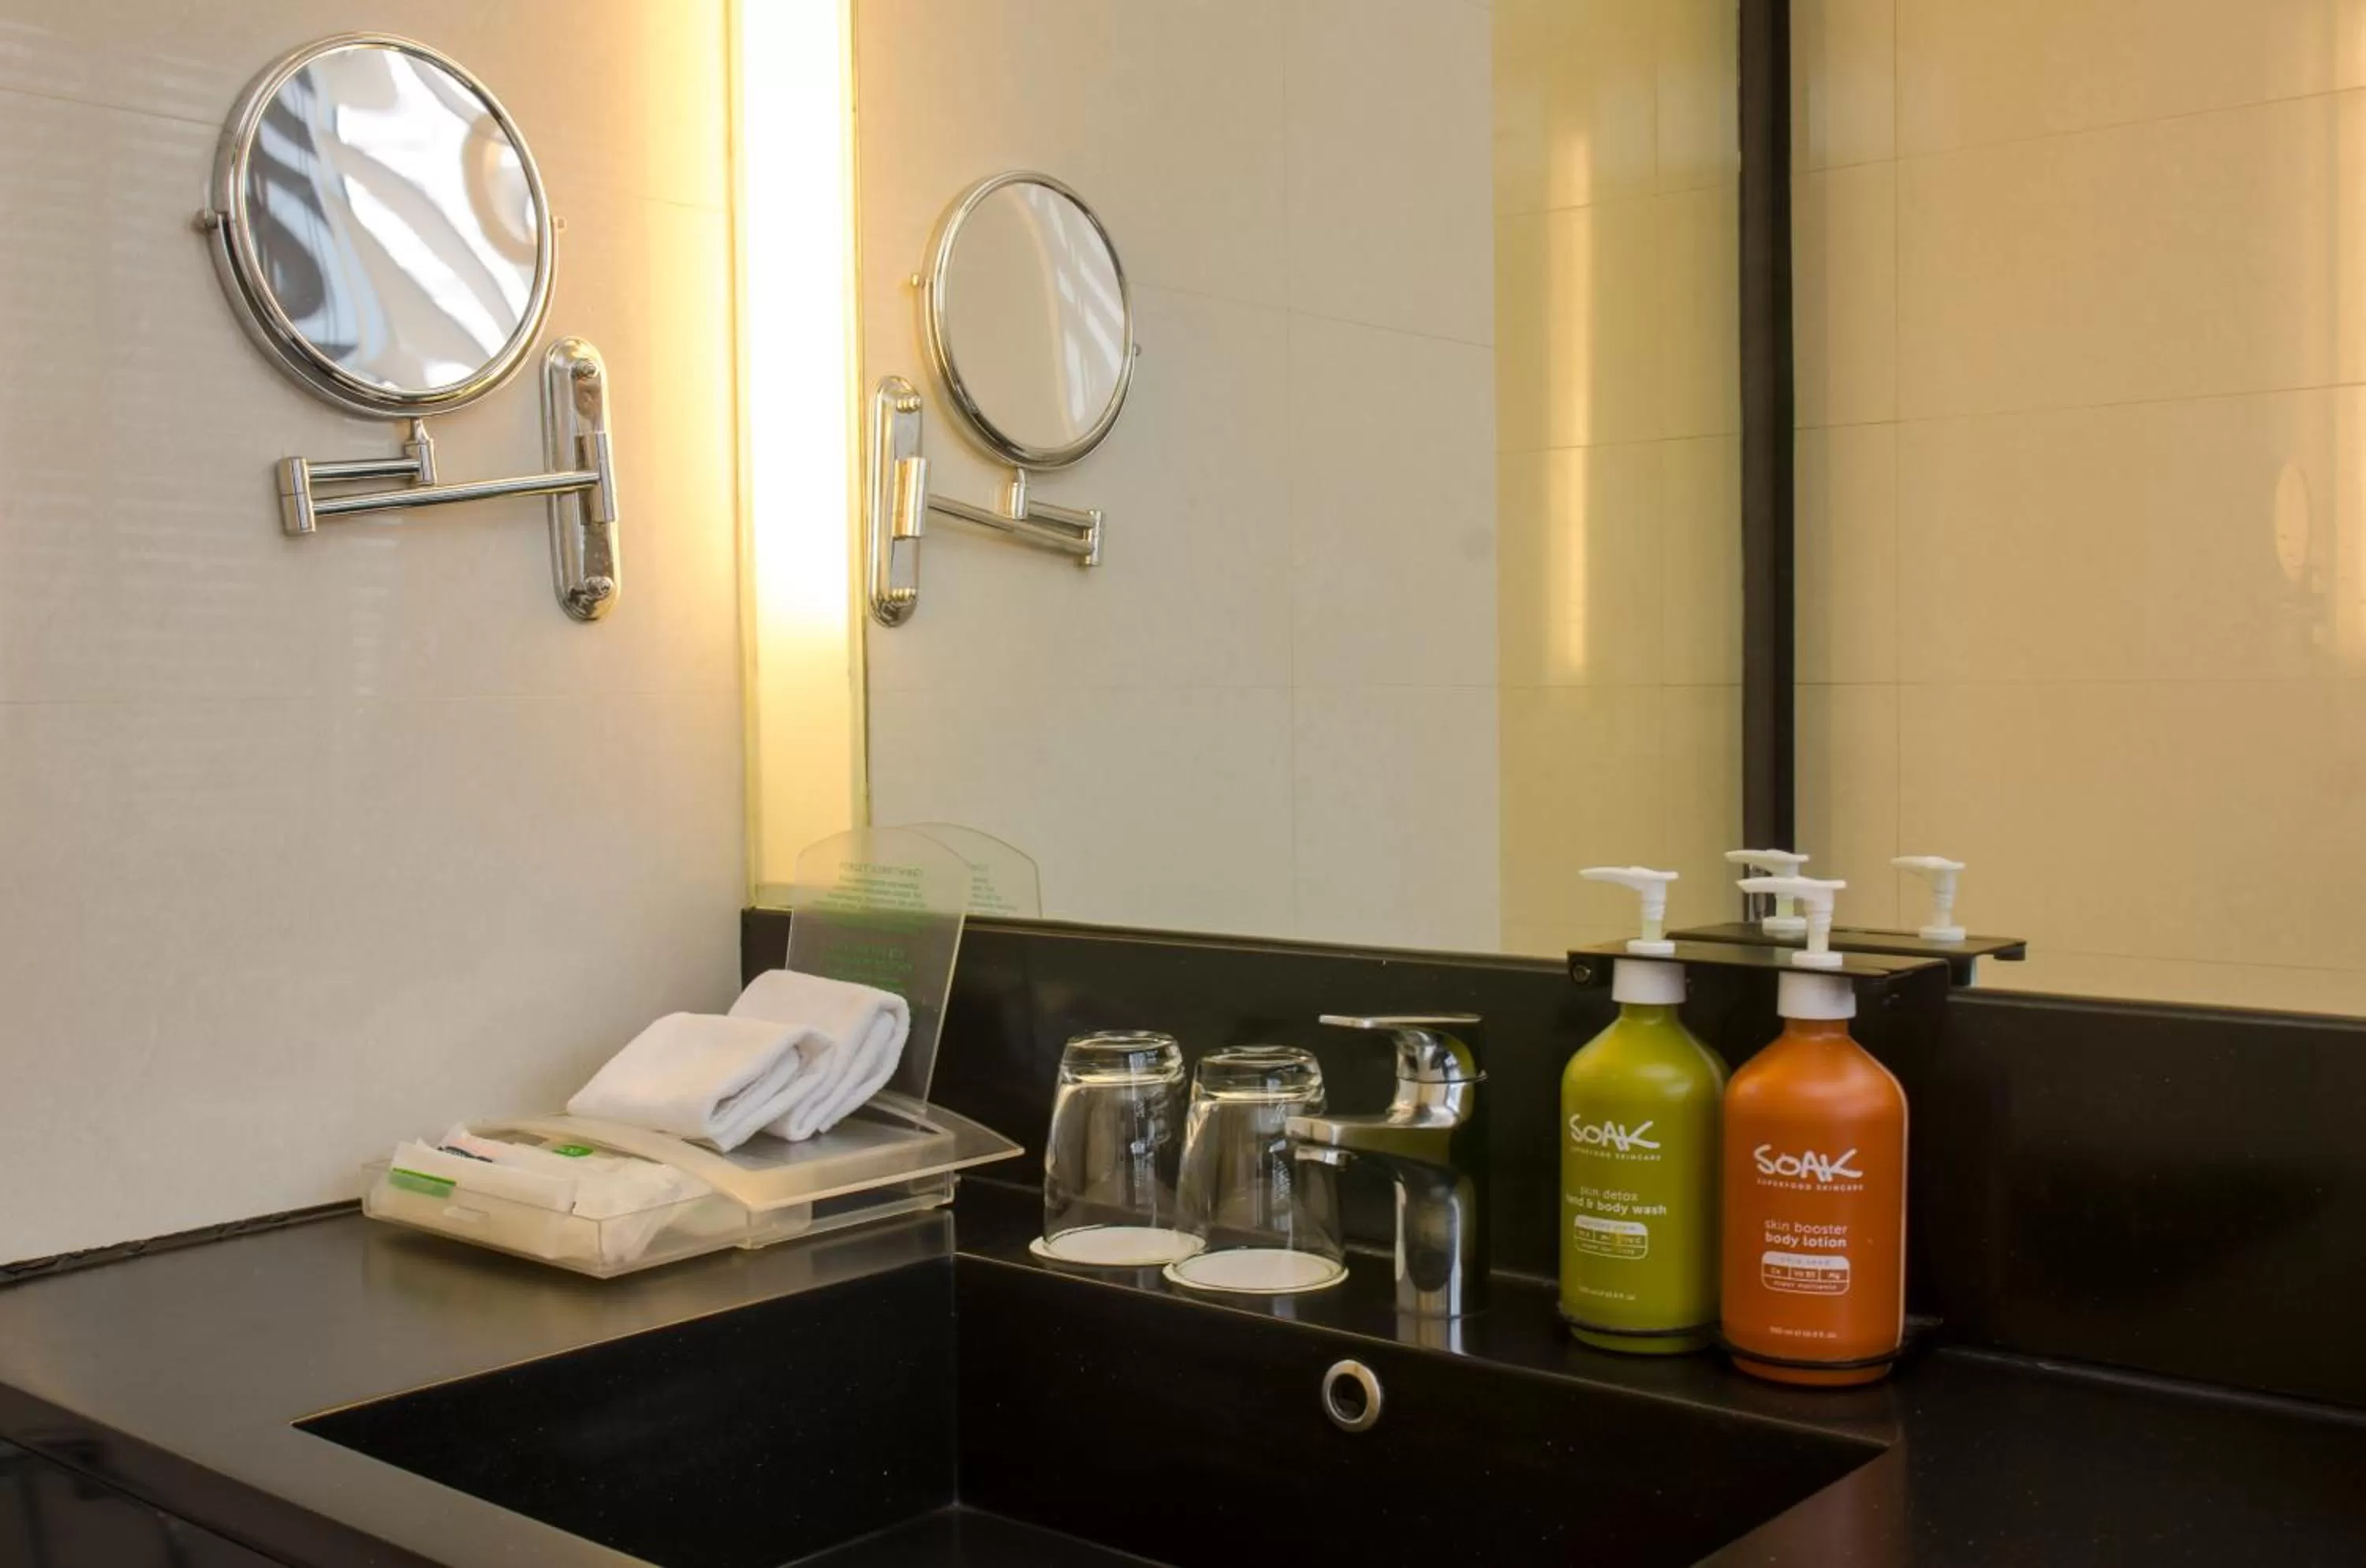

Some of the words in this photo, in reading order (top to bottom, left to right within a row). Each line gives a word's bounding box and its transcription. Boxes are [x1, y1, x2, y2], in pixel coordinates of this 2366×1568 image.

[1569, 1113, 1662, 1152] SOAK
[1753, 1144, 1864, 1182] SOAK
[1602, 1189, 1640, 1201] detox
[1597, 1200, 1629, 1215] body
[1632, 1204, 1667, 1215] wash
[1763, 1219, 1790, 1232] skin
[1794, 1222, 1848, 1235] booster
[1765, 1230, 1799, 1249] body
[1802, 1234, 1847, 1248] lotion
